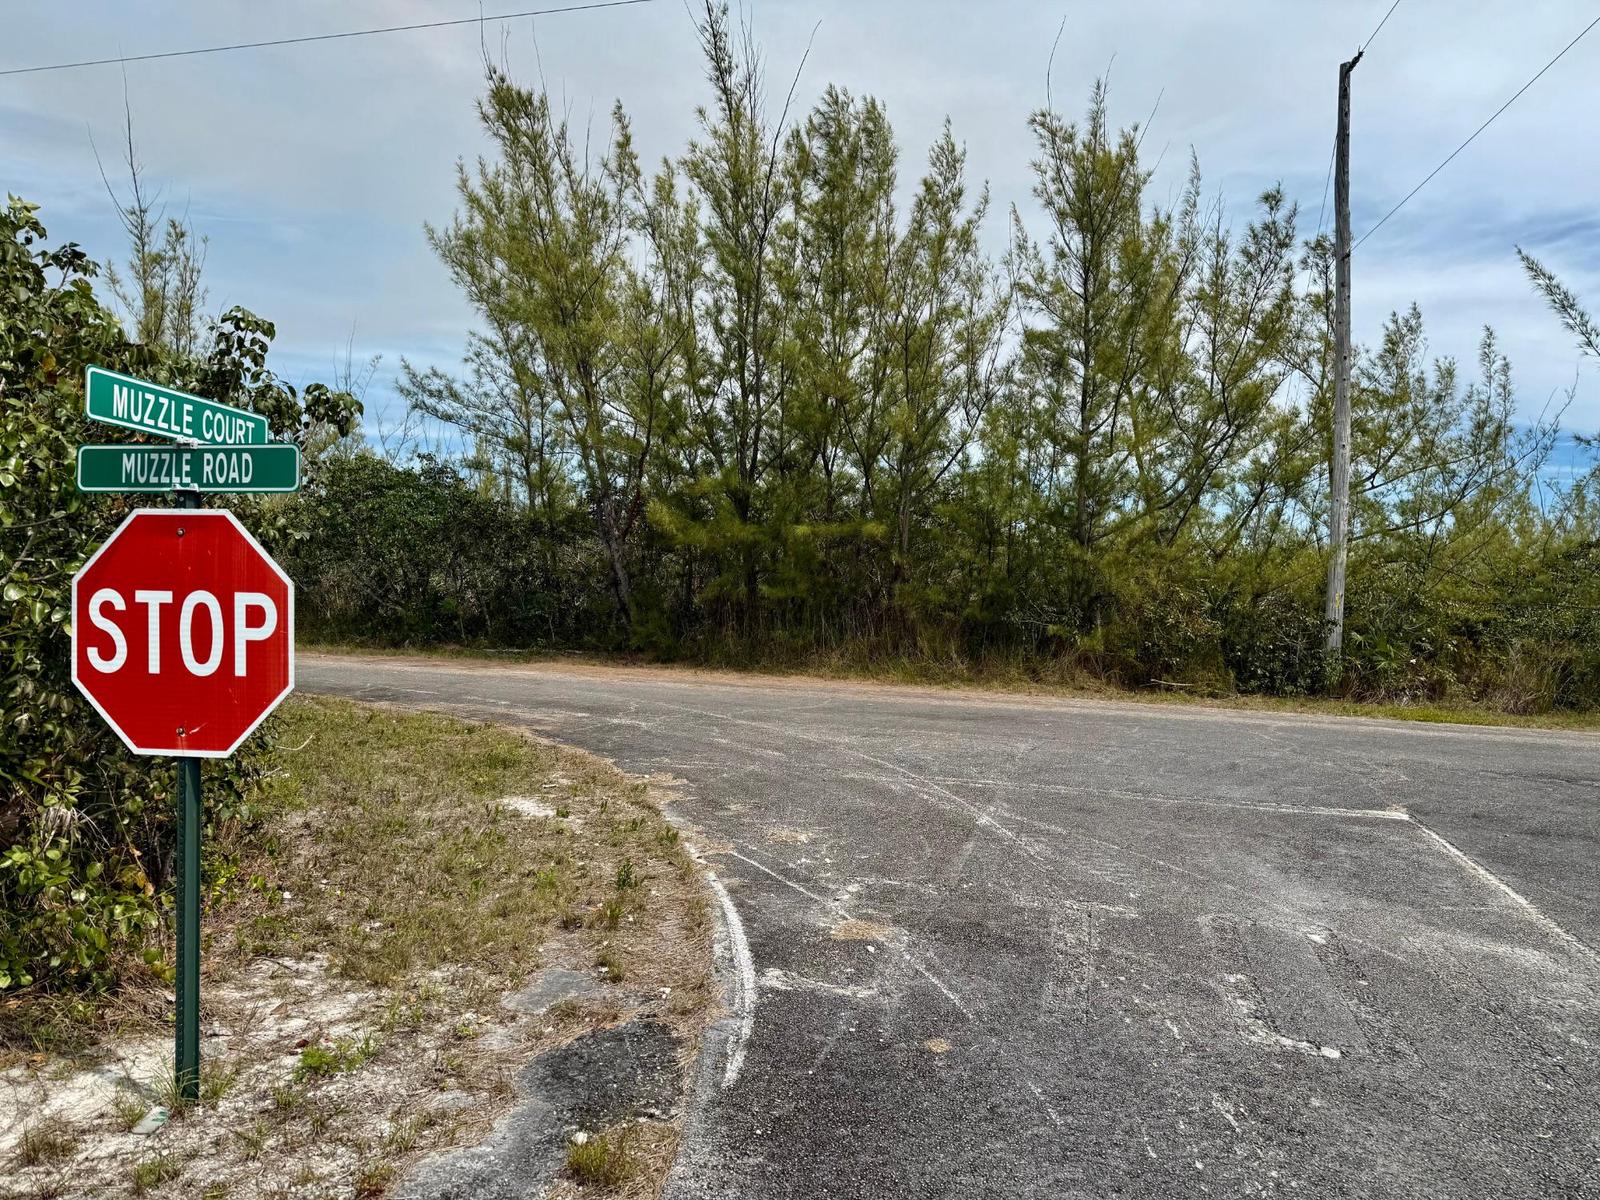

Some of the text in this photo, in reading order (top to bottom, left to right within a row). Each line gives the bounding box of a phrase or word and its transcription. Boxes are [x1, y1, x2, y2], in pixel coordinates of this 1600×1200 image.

[113, 384, 255, 444] MUZZLE COURT
[122, 453, 253, 484] MUZZLE ROAD
[86, 587, 278, 677] STOP
